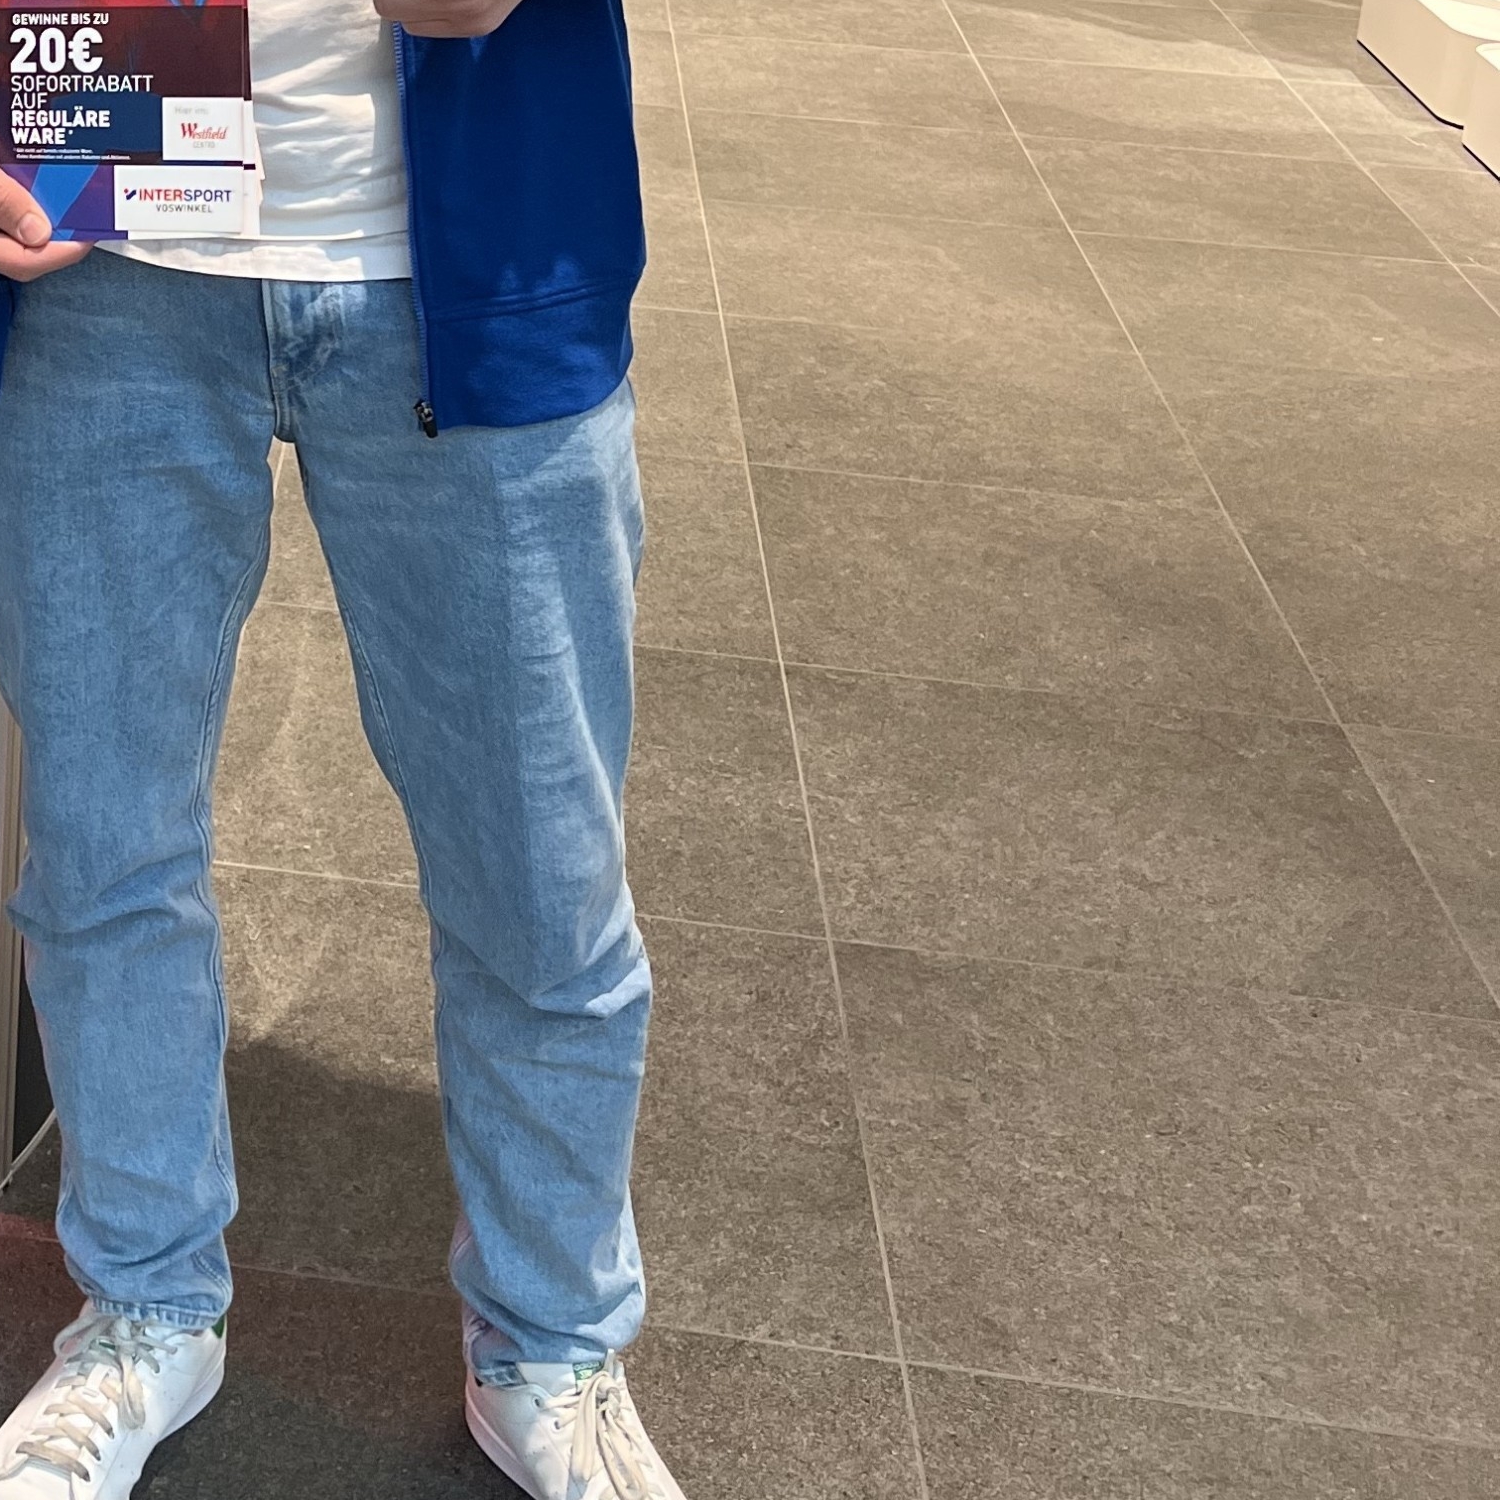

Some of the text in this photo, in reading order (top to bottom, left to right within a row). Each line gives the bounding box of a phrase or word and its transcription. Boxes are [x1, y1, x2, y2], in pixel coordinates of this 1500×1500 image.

[12, 12, 110, 26] GEWINNE BIS ZU
[9, 27, 104, 74] 20€
[10, 74, 154, 93] SOFORTRABATT
[10, 92, 48, 110] AUF
[11, 105, 111, 128] REGULÄRE
[181, 122, 229, 140] Westfield
[138, 188, 233, 203] INTERSPORT
[155, 204, 213, 213] VOSWINKEL
